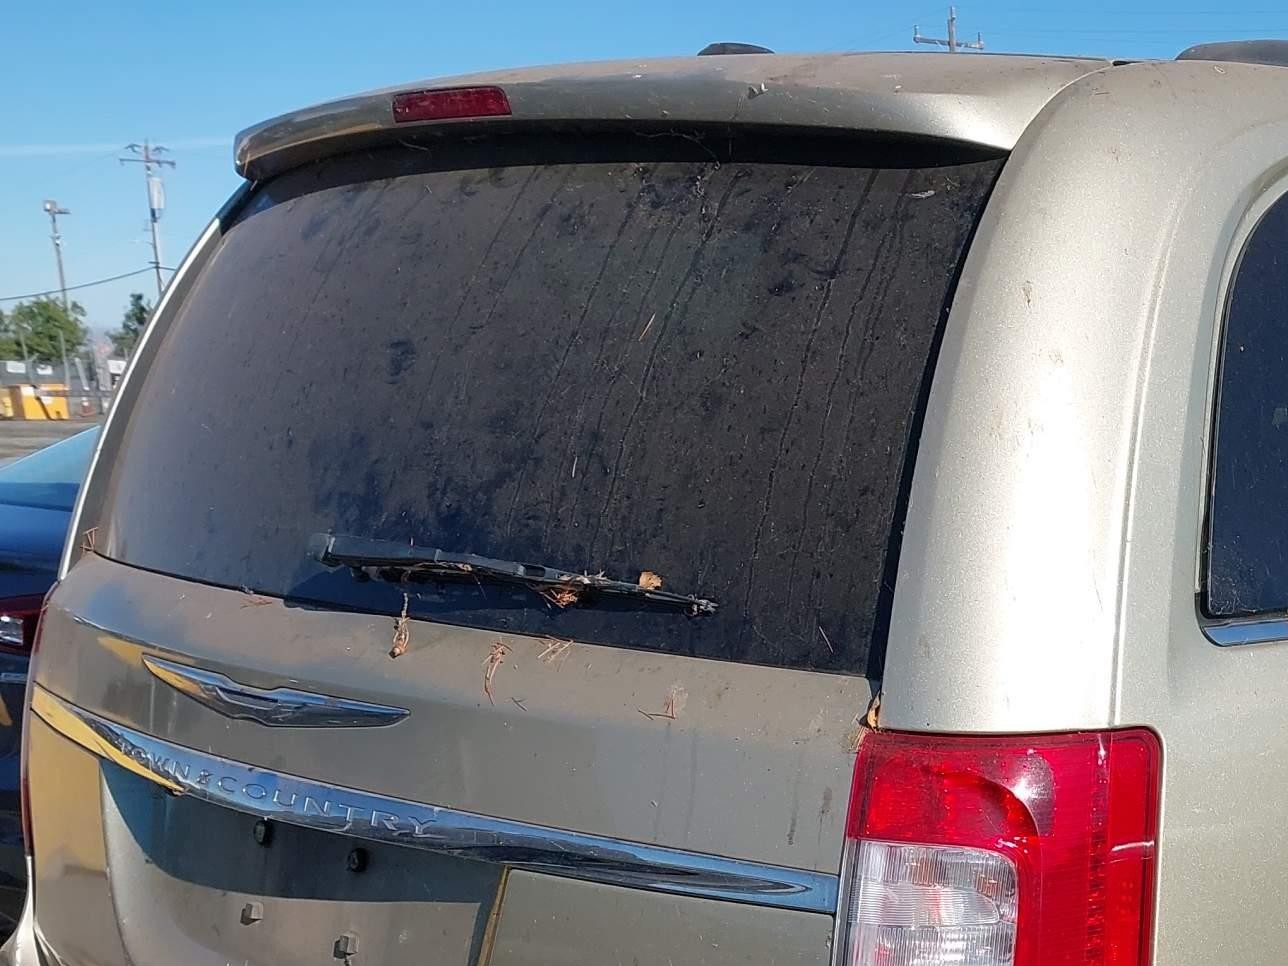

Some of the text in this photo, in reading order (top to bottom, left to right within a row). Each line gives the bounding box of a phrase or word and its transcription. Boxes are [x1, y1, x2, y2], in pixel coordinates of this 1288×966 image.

[115, 738, 437, 835] TOWN & COUNTRY
